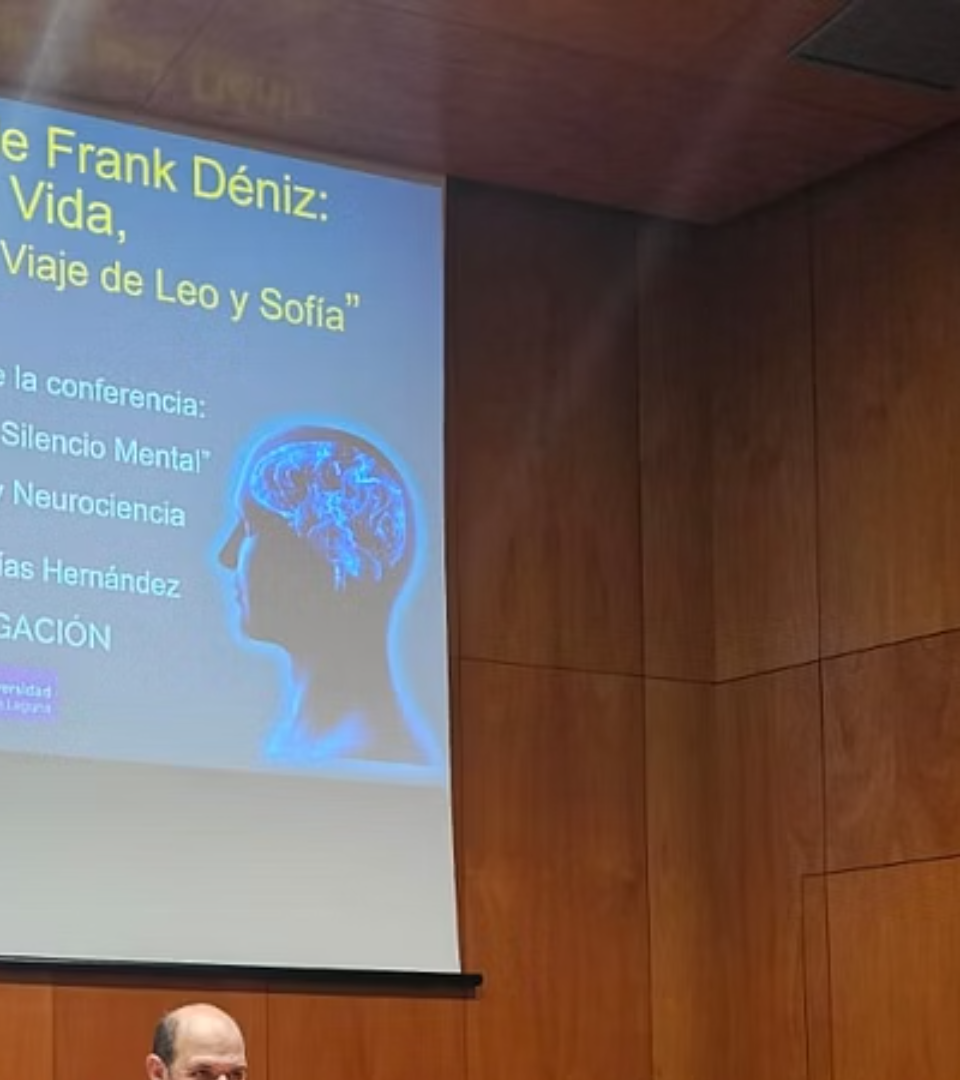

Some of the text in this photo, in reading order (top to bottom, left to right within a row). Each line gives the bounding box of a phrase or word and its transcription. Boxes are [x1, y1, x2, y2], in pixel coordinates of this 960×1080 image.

[47, 126, 178, 192] Frank
[193, 156, 329, 221] Déniz:
[11, 175, 126, 244] Vida,
[0, 240, 89, 291] Viaje
[100, 260, 143, 296] de
[156, 269, 220, 310] Leo
[231, 289, 249, 322] y
[15, 364, 37, 394] la
[47, 374, 206, 419] conferencia:
[1, 420, 106, 460] Silencio
[13, 479, 186, 528] Neurociencia
[43, 557, 182, 600] Hernández
[6, 698, 52, 715] Laguna
